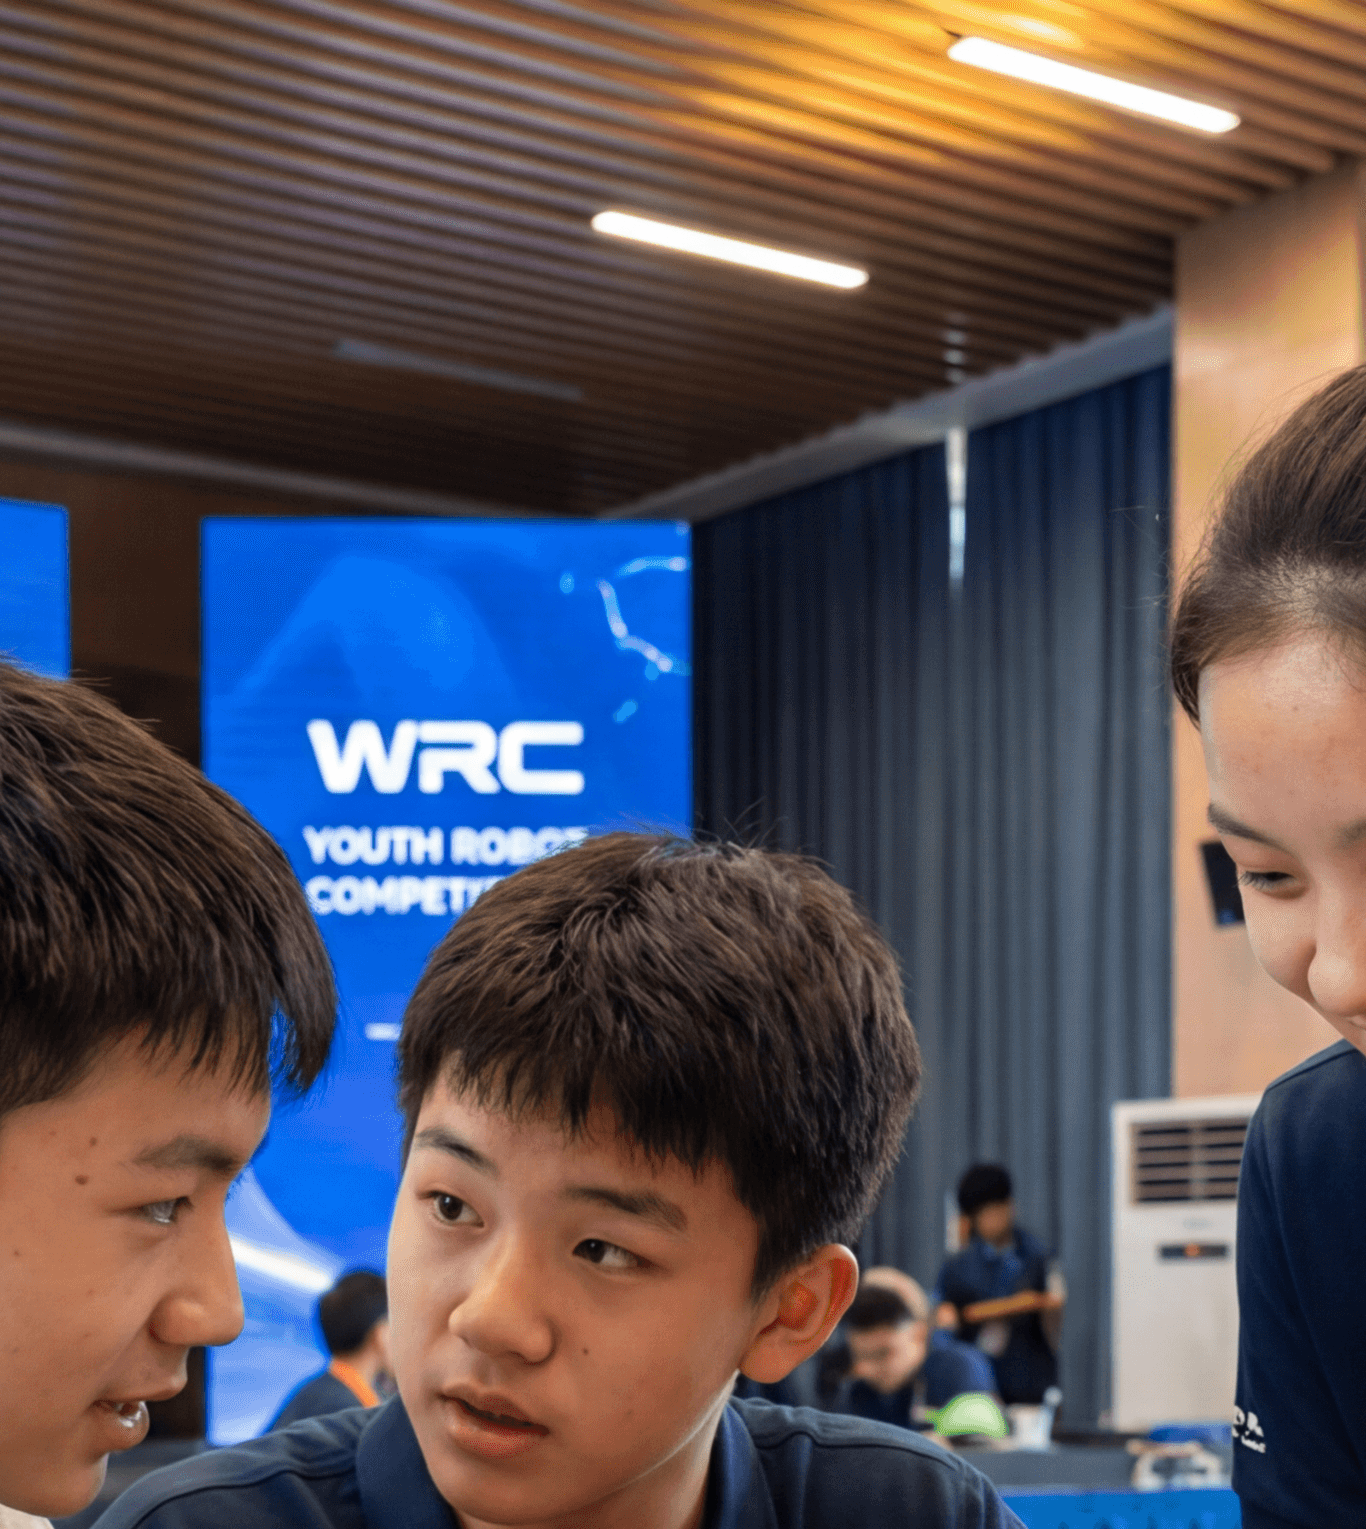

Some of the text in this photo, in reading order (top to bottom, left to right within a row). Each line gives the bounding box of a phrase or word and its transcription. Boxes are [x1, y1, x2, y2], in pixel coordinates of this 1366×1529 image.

[307, 720, 584, 795] WRC
[303, 826, 444, 866] YOUTH
[305, 875, 505, 916] COMPETI
